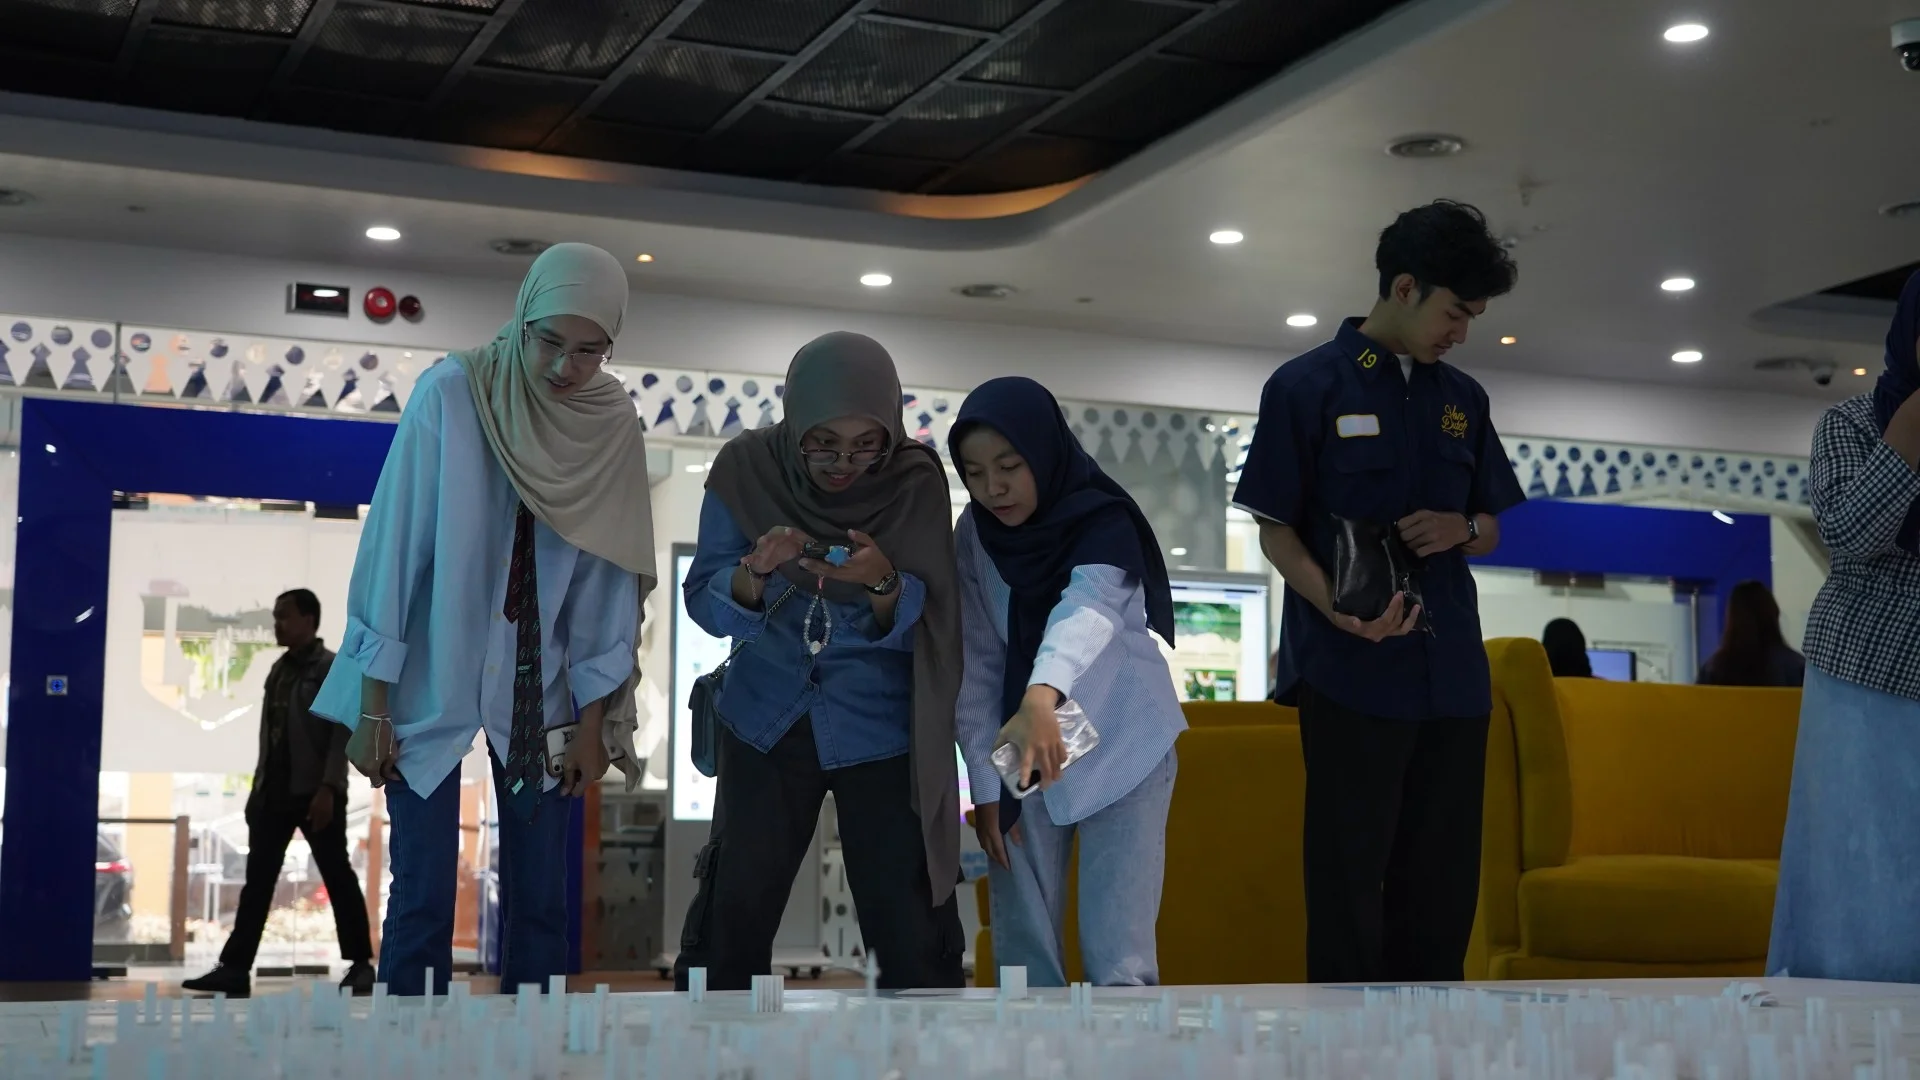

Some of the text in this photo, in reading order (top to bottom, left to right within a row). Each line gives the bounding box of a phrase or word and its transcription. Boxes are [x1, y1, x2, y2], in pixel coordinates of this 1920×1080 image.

[1357, 347, 1377, 369] 19
[1444, 404, 1465, 421] Von
[1441, 415, 1468, 433] Dutch
